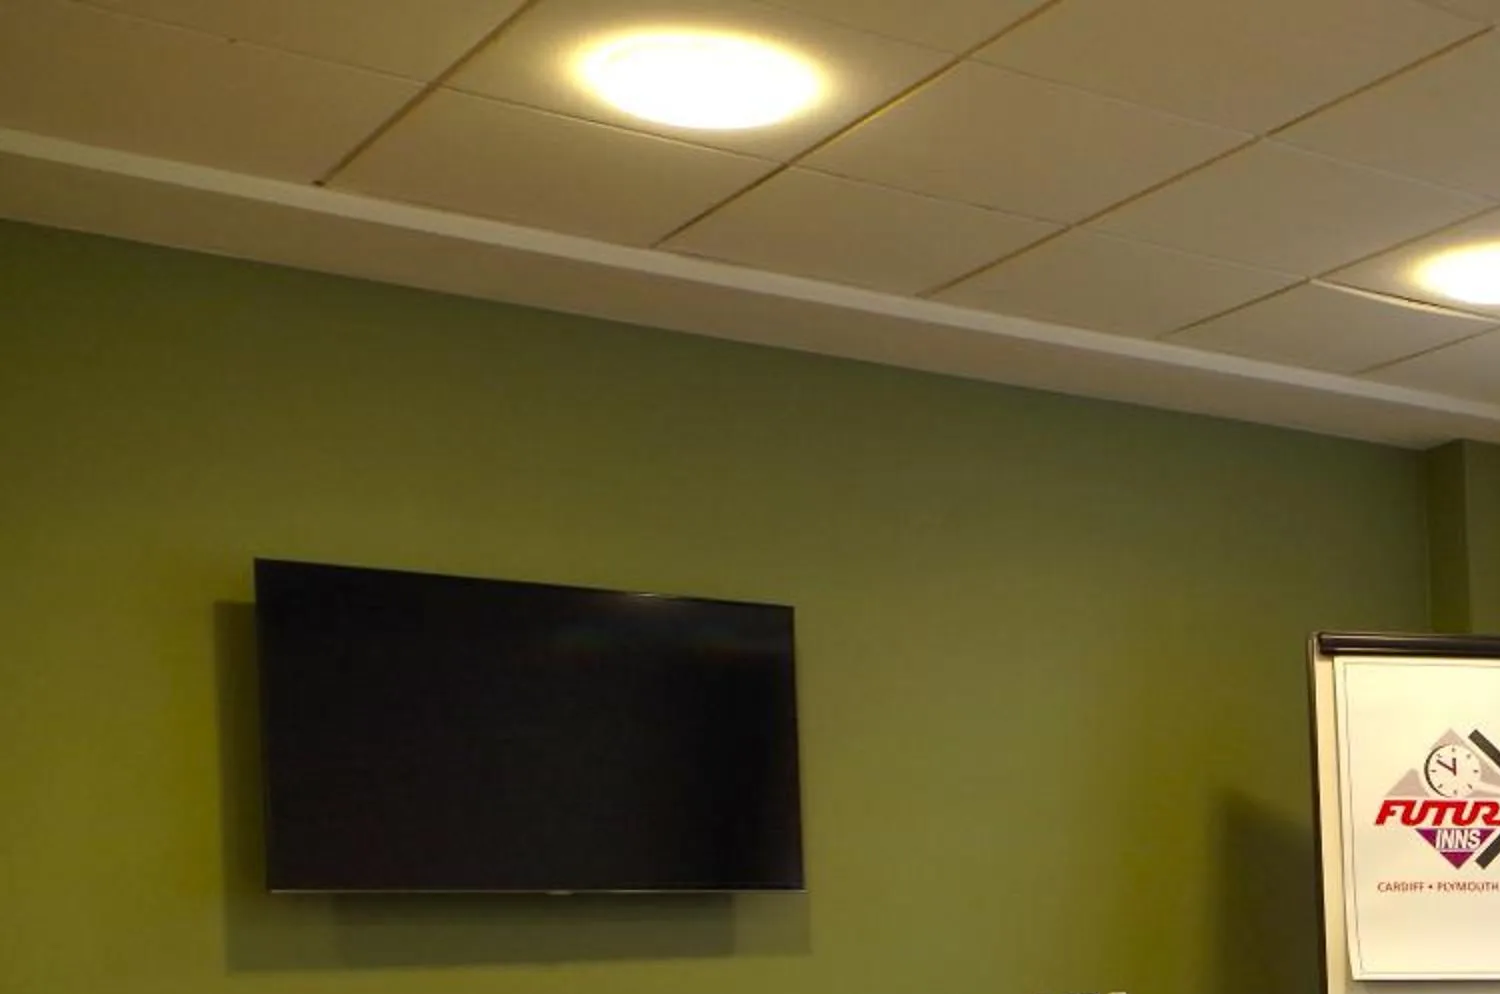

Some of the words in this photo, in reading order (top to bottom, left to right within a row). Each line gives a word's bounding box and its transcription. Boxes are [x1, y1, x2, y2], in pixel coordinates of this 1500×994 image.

[1435, 829, 1481, 849] INNS
[1377, 881, 1425, 893] CARDIFF
[1437, 881, 1499, 893] PLYMOUTH
